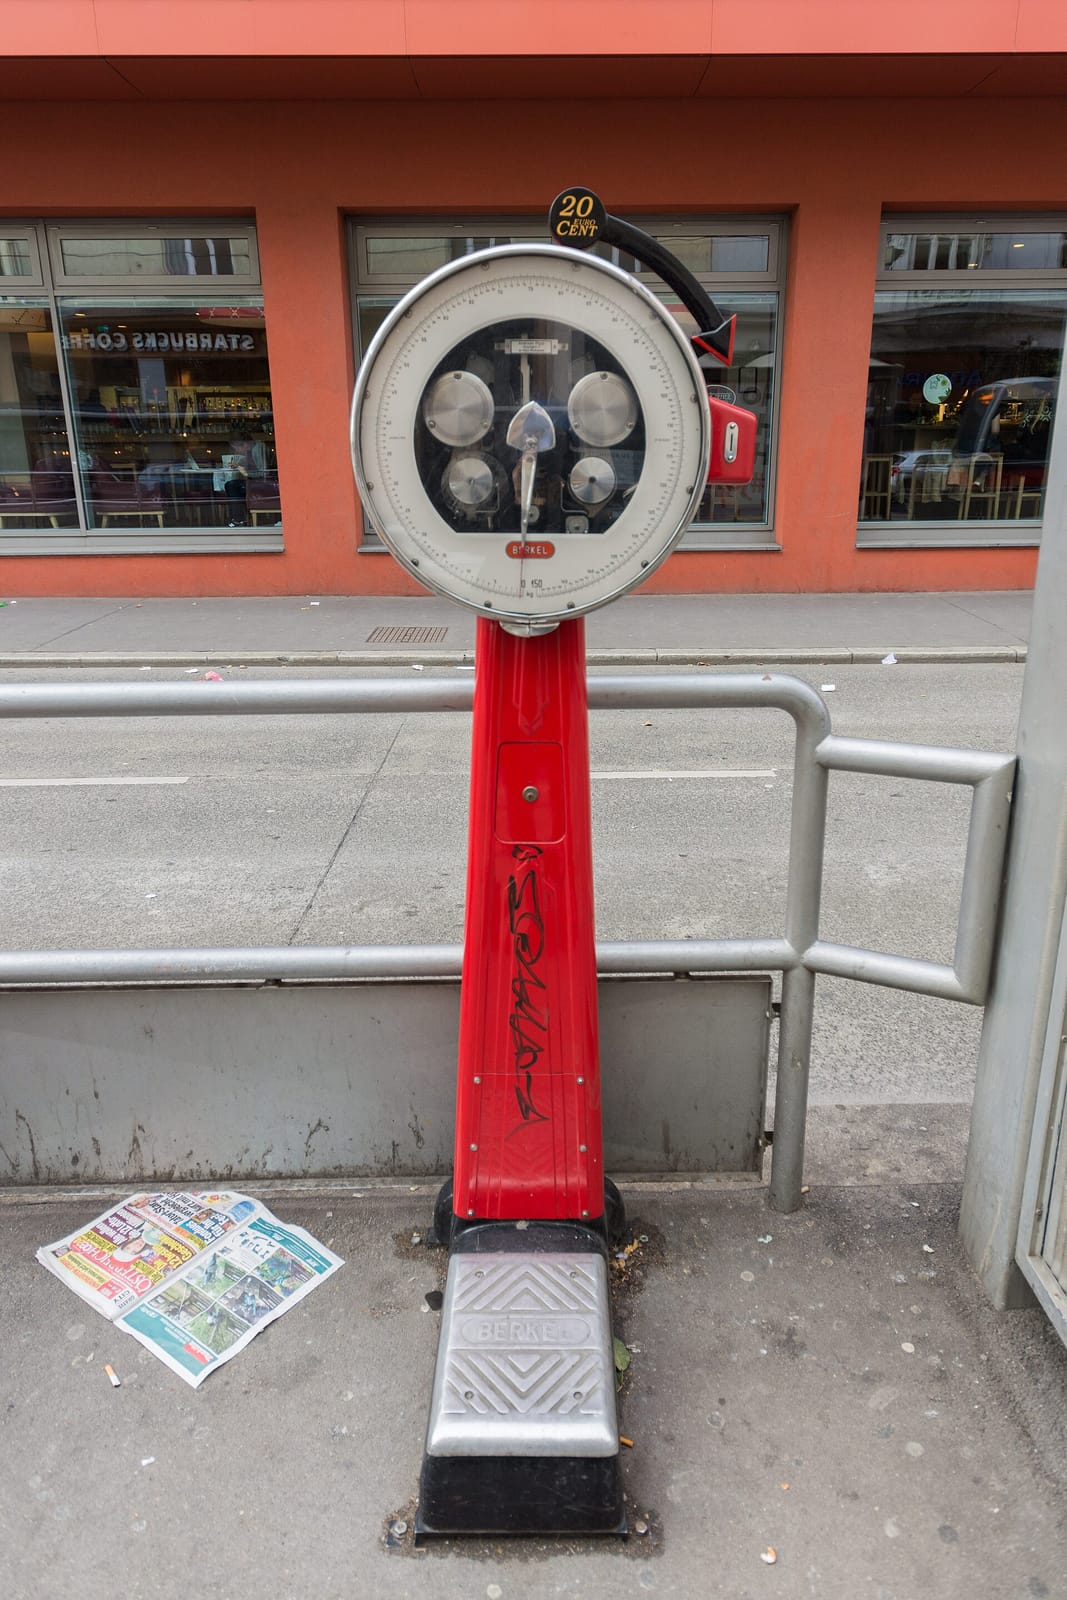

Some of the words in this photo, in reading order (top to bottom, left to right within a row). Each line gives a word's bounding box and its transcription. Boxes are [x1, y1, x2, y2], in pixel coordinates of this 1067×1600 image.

[559, 195, 594, 217] 20
[556, 220, 598, 237] CENT
[573, 218, 596, 226] EURO
[531, 579, 543, 589] 150
[159, 1197, 195, 1218] vergleicht
[118, 1224, 132, 1236] 12
[187, 1220, 213, 1244] Fondues
[169, 1256, 182, 1271] 12
[113, 1290, 130, 1304] CITY
[478, 1321, 572, 1342] BERKEL
